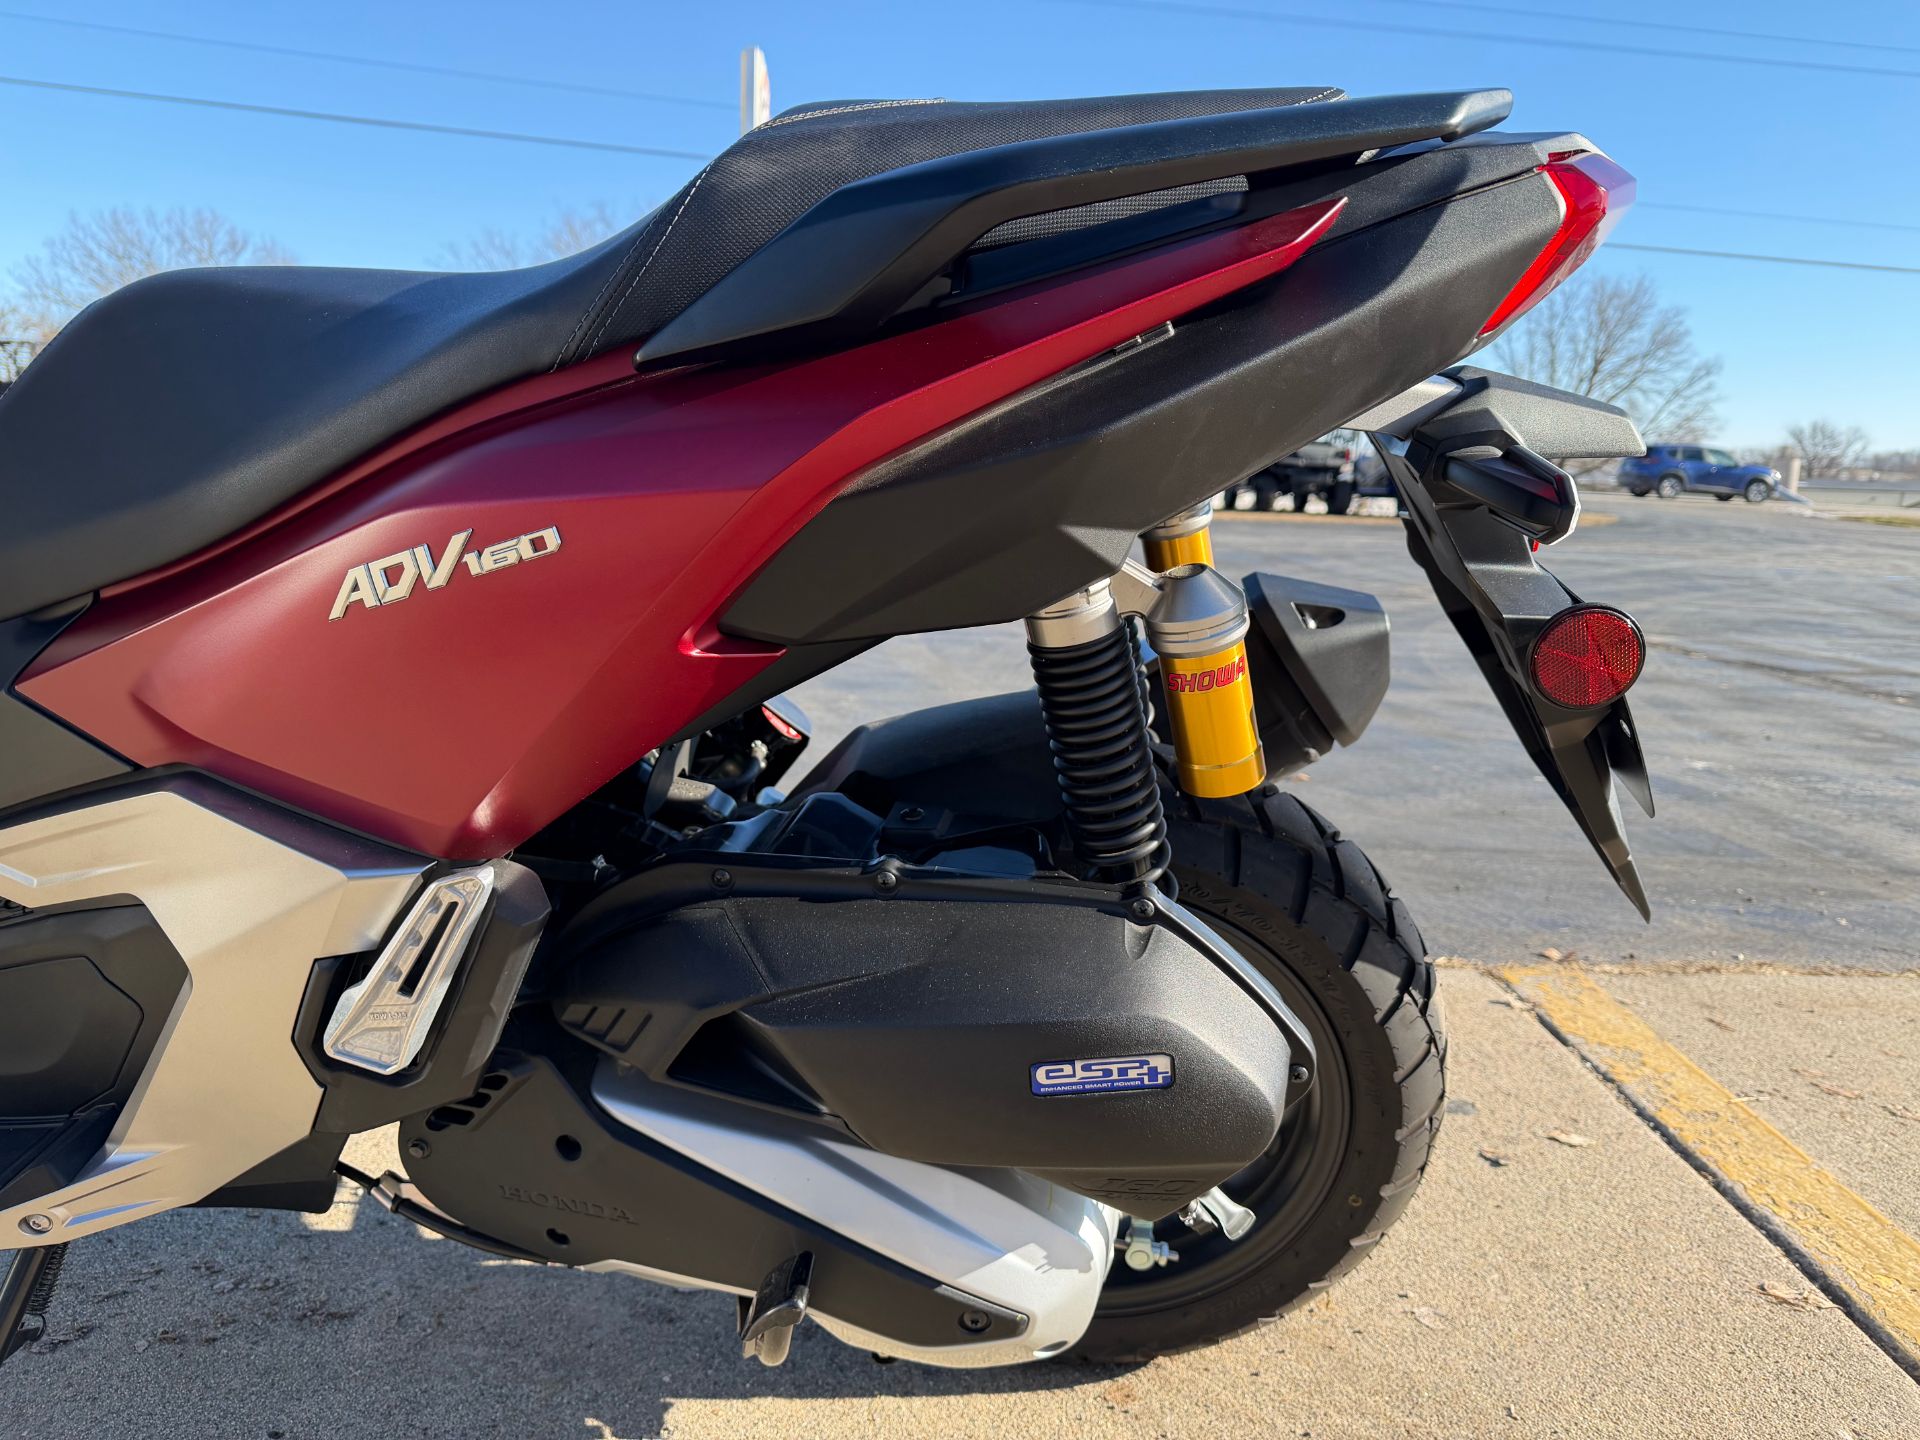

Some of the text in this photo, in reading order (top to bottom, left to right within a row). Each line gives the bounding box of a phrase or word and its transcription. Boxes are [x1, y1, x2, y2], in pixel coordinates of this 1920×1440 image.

[1168, 655, 1246, 693] SHOWA
[1040, 1084, 1083, 1092] ENHANCED
[498, 1184, 640, 1226] HONDA
